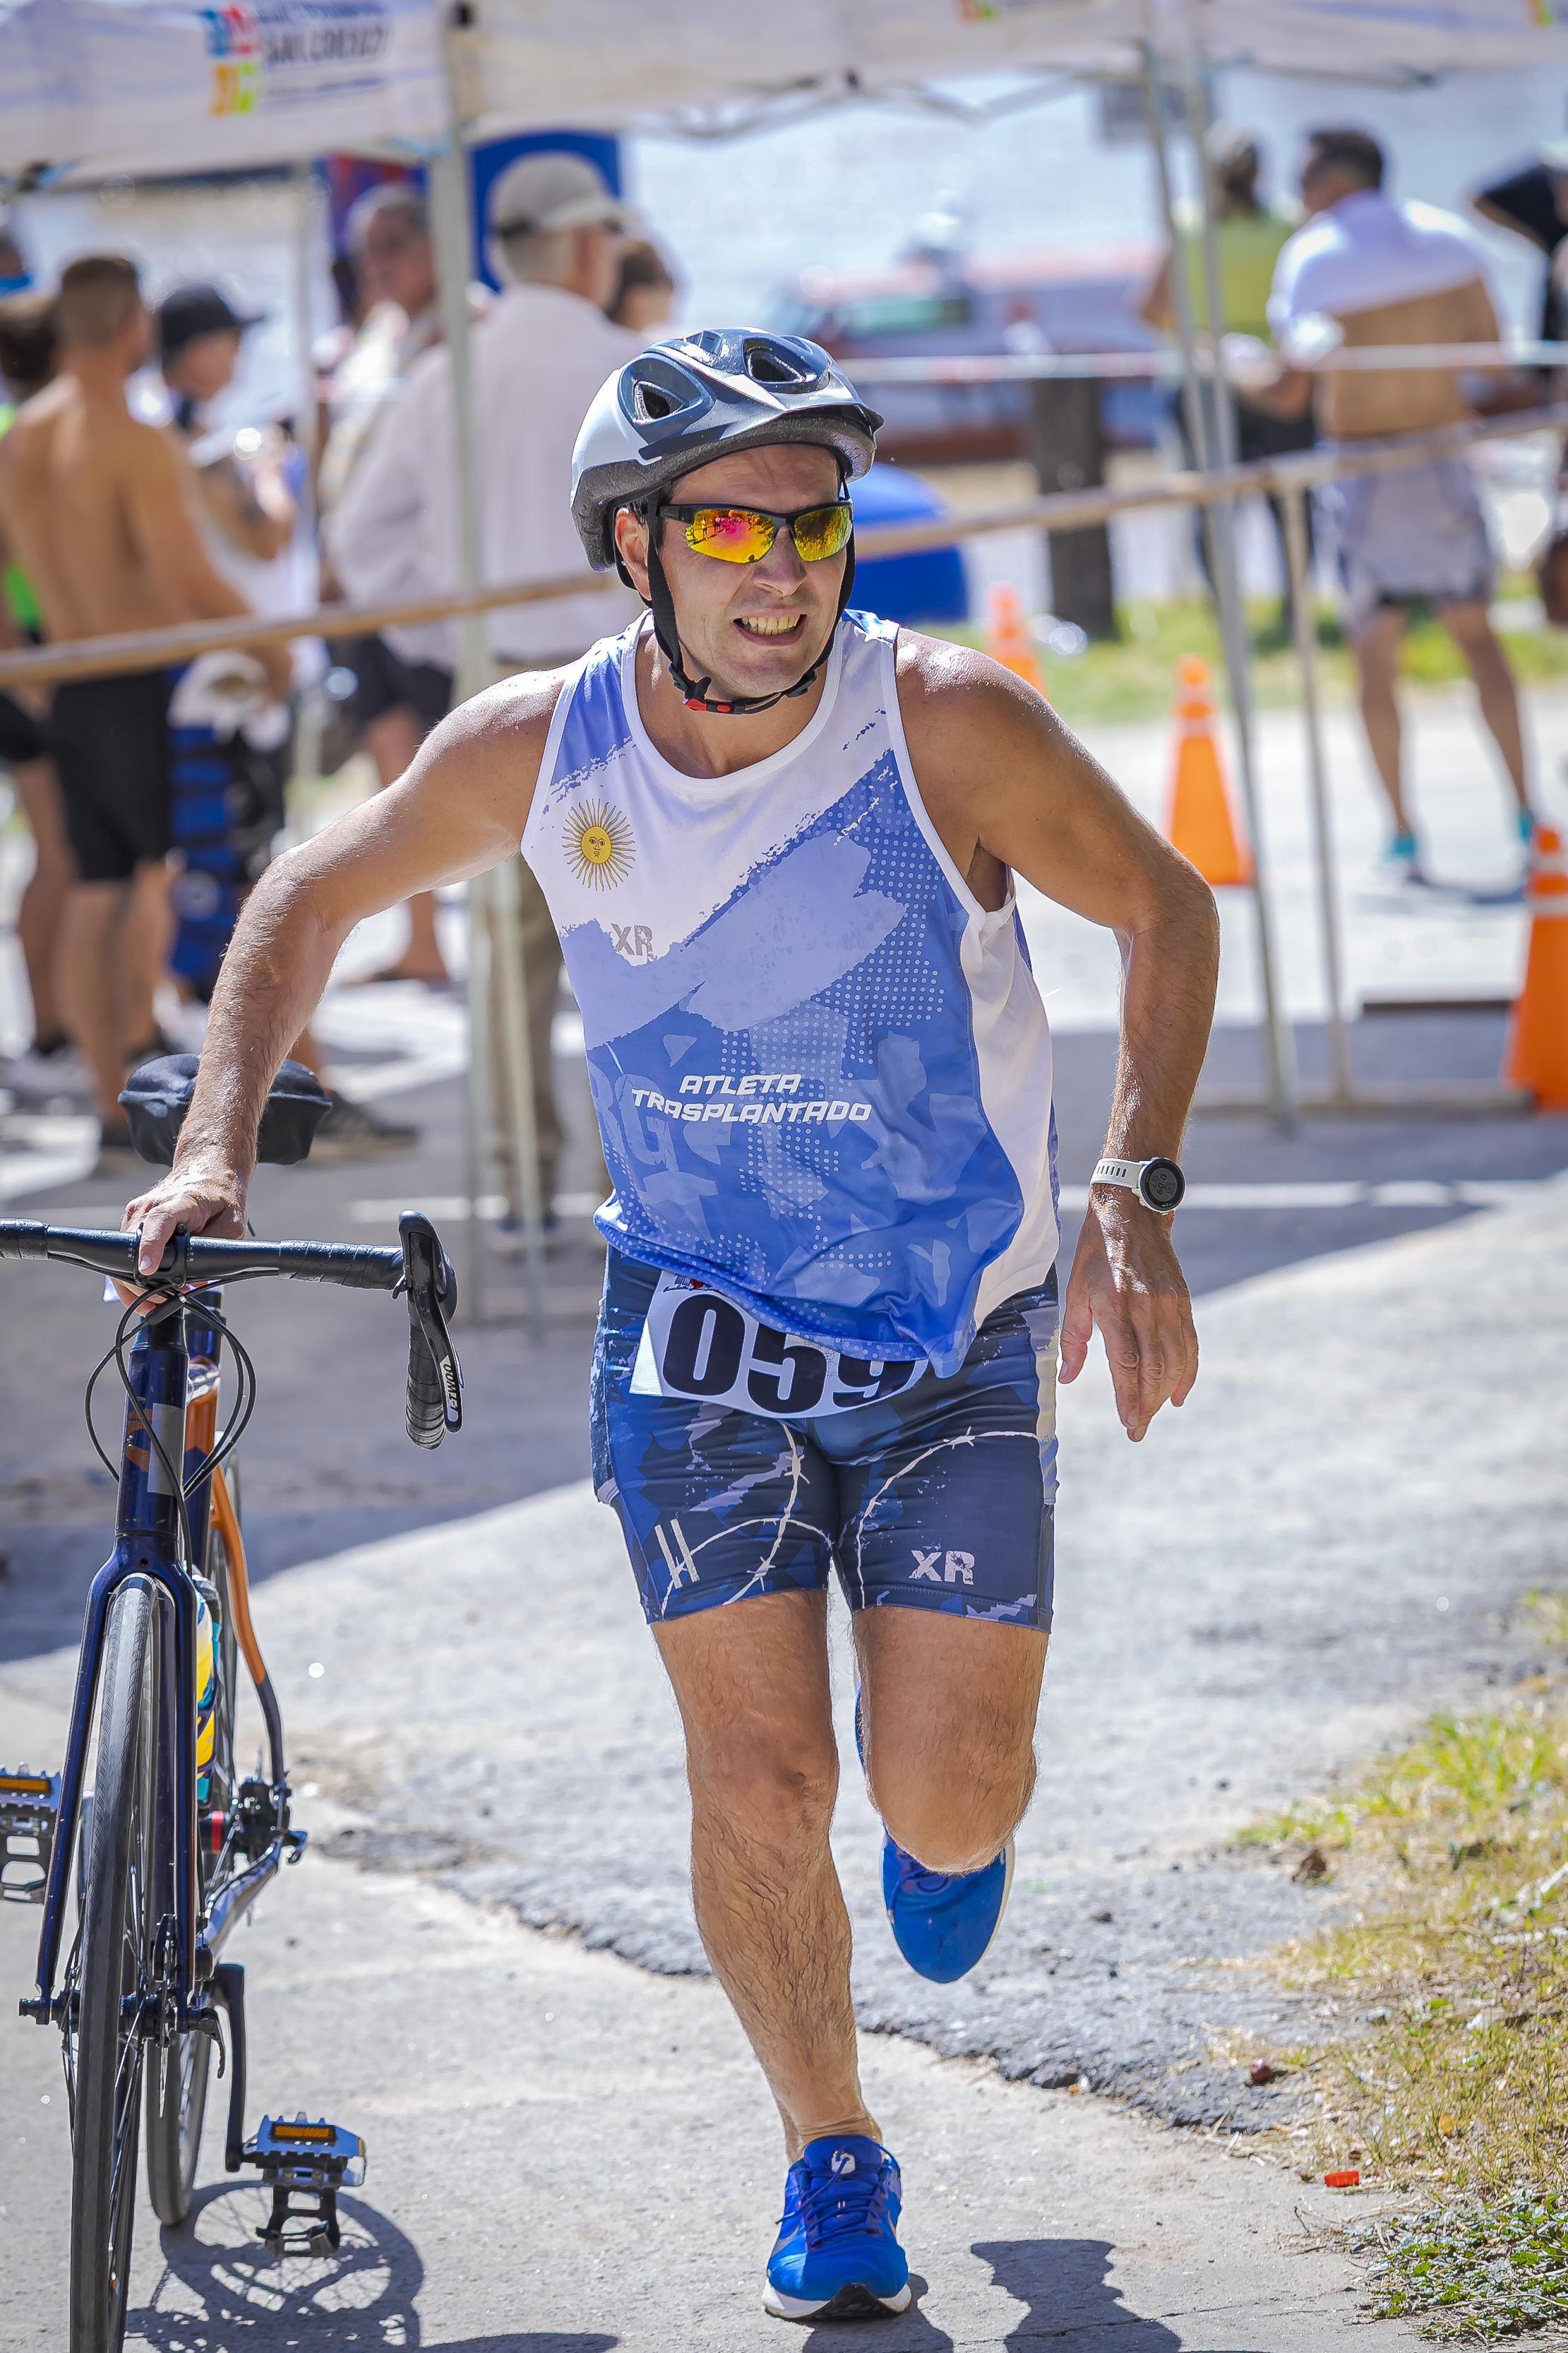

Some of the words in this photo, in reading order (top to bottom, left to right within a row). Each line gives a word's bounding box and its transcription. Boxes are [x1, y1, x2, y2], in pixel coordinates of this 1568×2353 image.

[611, 923, 655, 959] XR
[678, 1073, 802, 1096] ATLETA
[630, 1088, 873, 1124] TRASPLANTADO
[908, 1549, 975, 1585] XR
